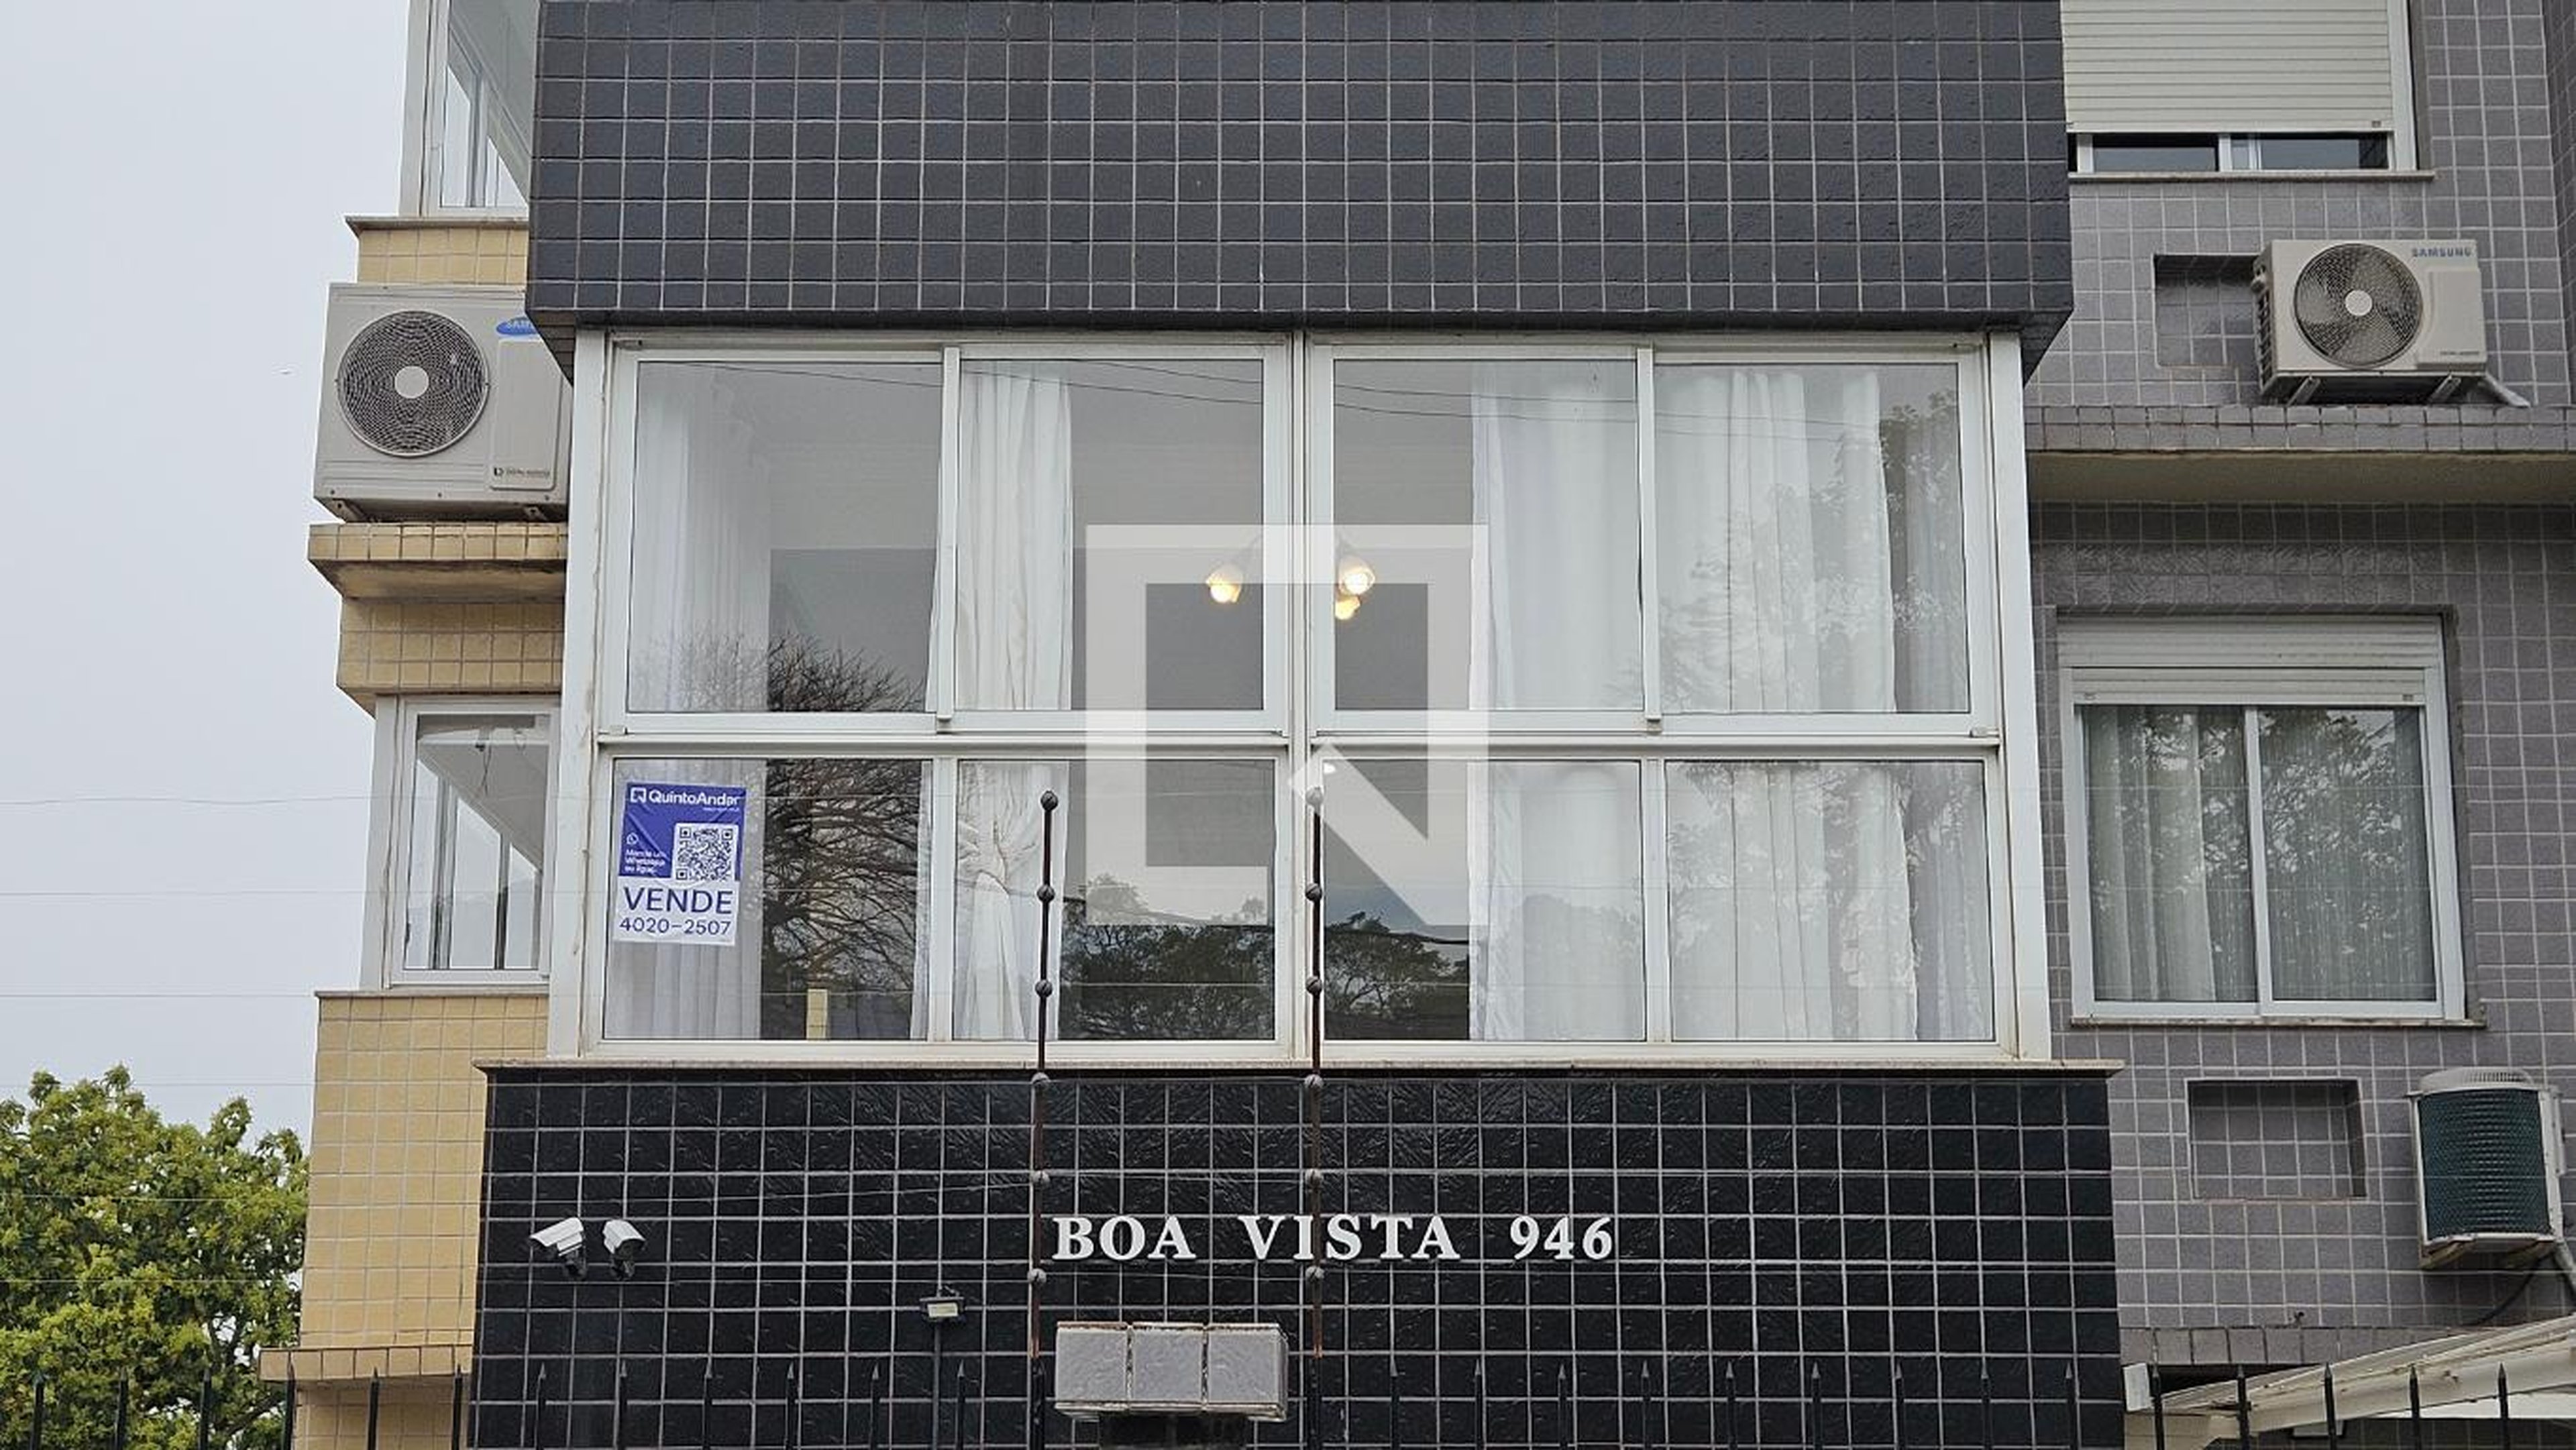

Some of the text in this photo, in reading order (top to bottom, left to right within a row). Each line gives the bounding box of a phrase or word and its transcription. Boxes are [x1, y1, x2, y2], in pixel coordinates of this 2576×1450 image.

[2412, 247, 2471, 258] SAMSUNG
[649, 790, 739, 806] QuintoAndar
[623, 887, 734, 915] VENDE
[619, 917, 731, 935] 4020-2507
[1051, 1215, 1613, 1260] BOA VISTA 946
